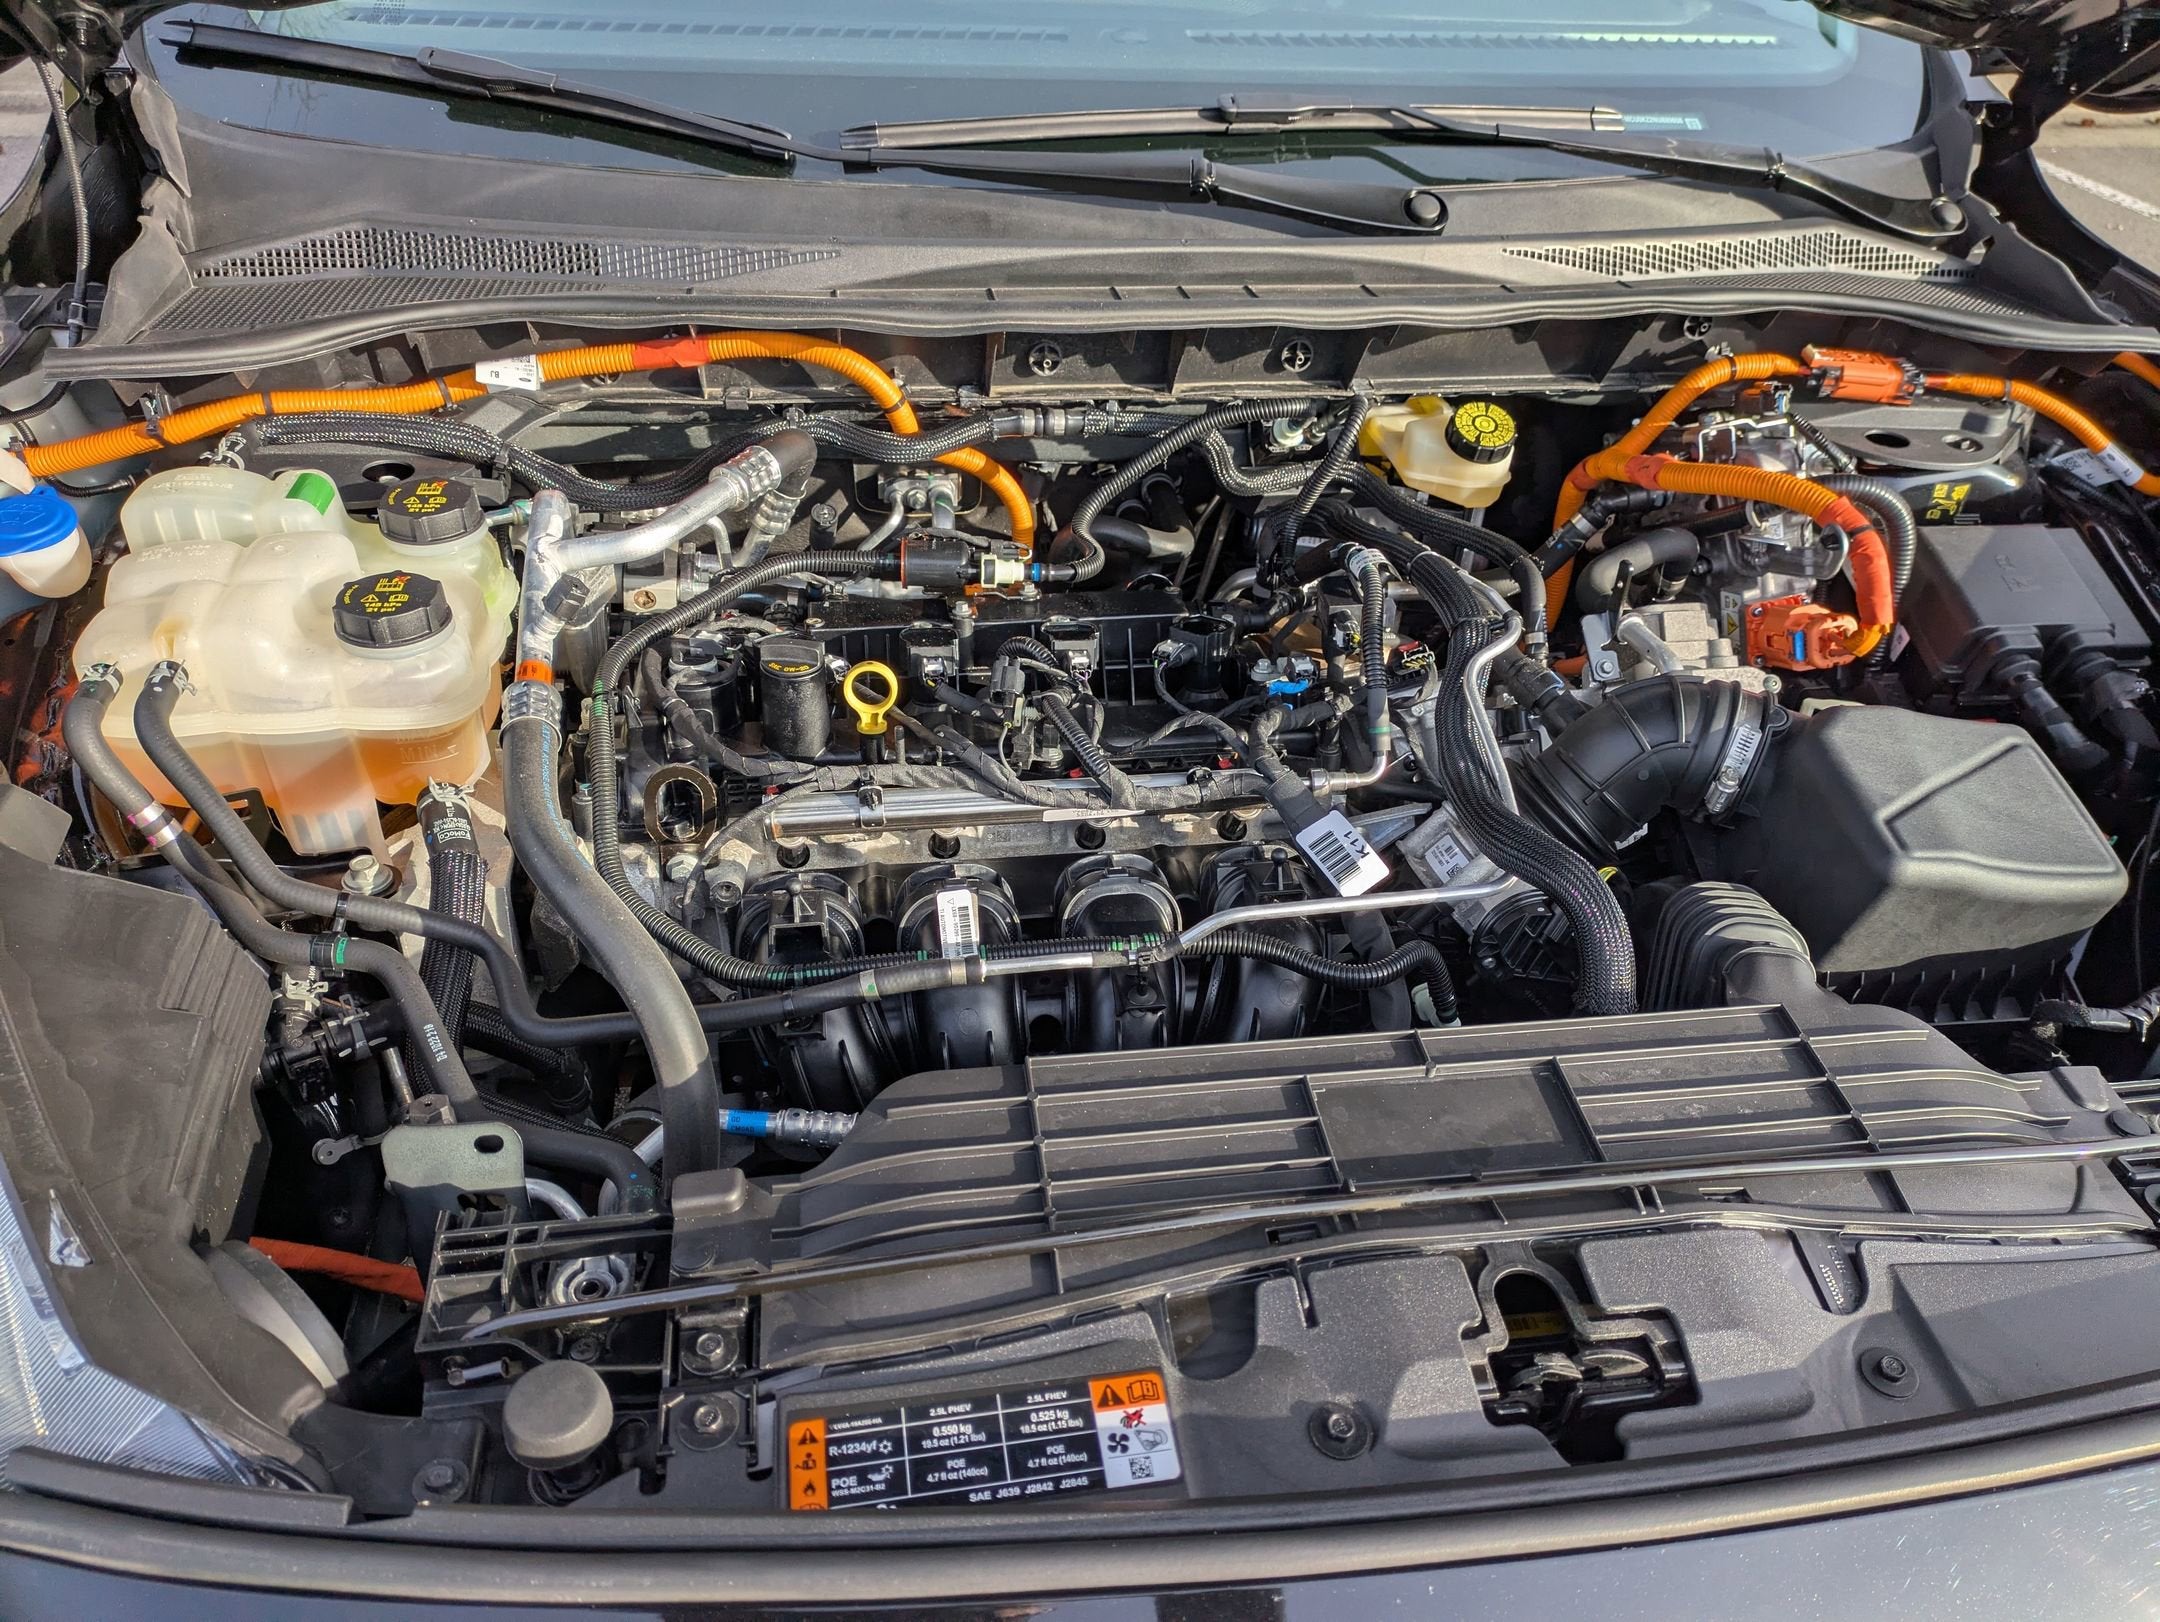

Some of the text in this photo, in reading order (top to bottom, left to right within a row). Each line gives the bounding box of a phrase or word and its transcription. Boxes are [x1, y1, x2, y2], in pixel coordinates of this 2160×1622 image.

[490, 370, 500, 378] BJ
[1344, 830, 1370, 858] K11
[940, 914, 948, 944] AUTOMOTIVE
[1027, 1391, 1068, 1404] 2.5L FHEV
[929, 1403, 972, 1417] 2.5L PHEV
[1030, 1409, 1070, 1423] 0.525 kg
[932, 1423, 972, 1437] 0.550 kg
[1037, 1424, 1048, 1432] oz
[1048, 1420, 1067, 1432] (1.15
[1067, 1418, 1084, 1428] lbs)
[939, 1438, 950, 1447] oz
[950, 1435, 969, 1447] (1.21
[970, 1432, 987, 1442] lbs)
[828, 1440, 878, 1457] R-1234yf
[1046, 1444, 1066, 1455] POE
[946, 1458, 966, 1469] POE
[1048, 1458, 1058, 1466] oz
[1058, 1452, 1088, 1465] (140cc)
[947, 1471, 958, 1480] oz
[958, 1466, 988, 1480] (140cc)
[830, 1476, 858, 1489] POE
[969, 1477, 1089, 1503] SAE J639 J2842 J2845
